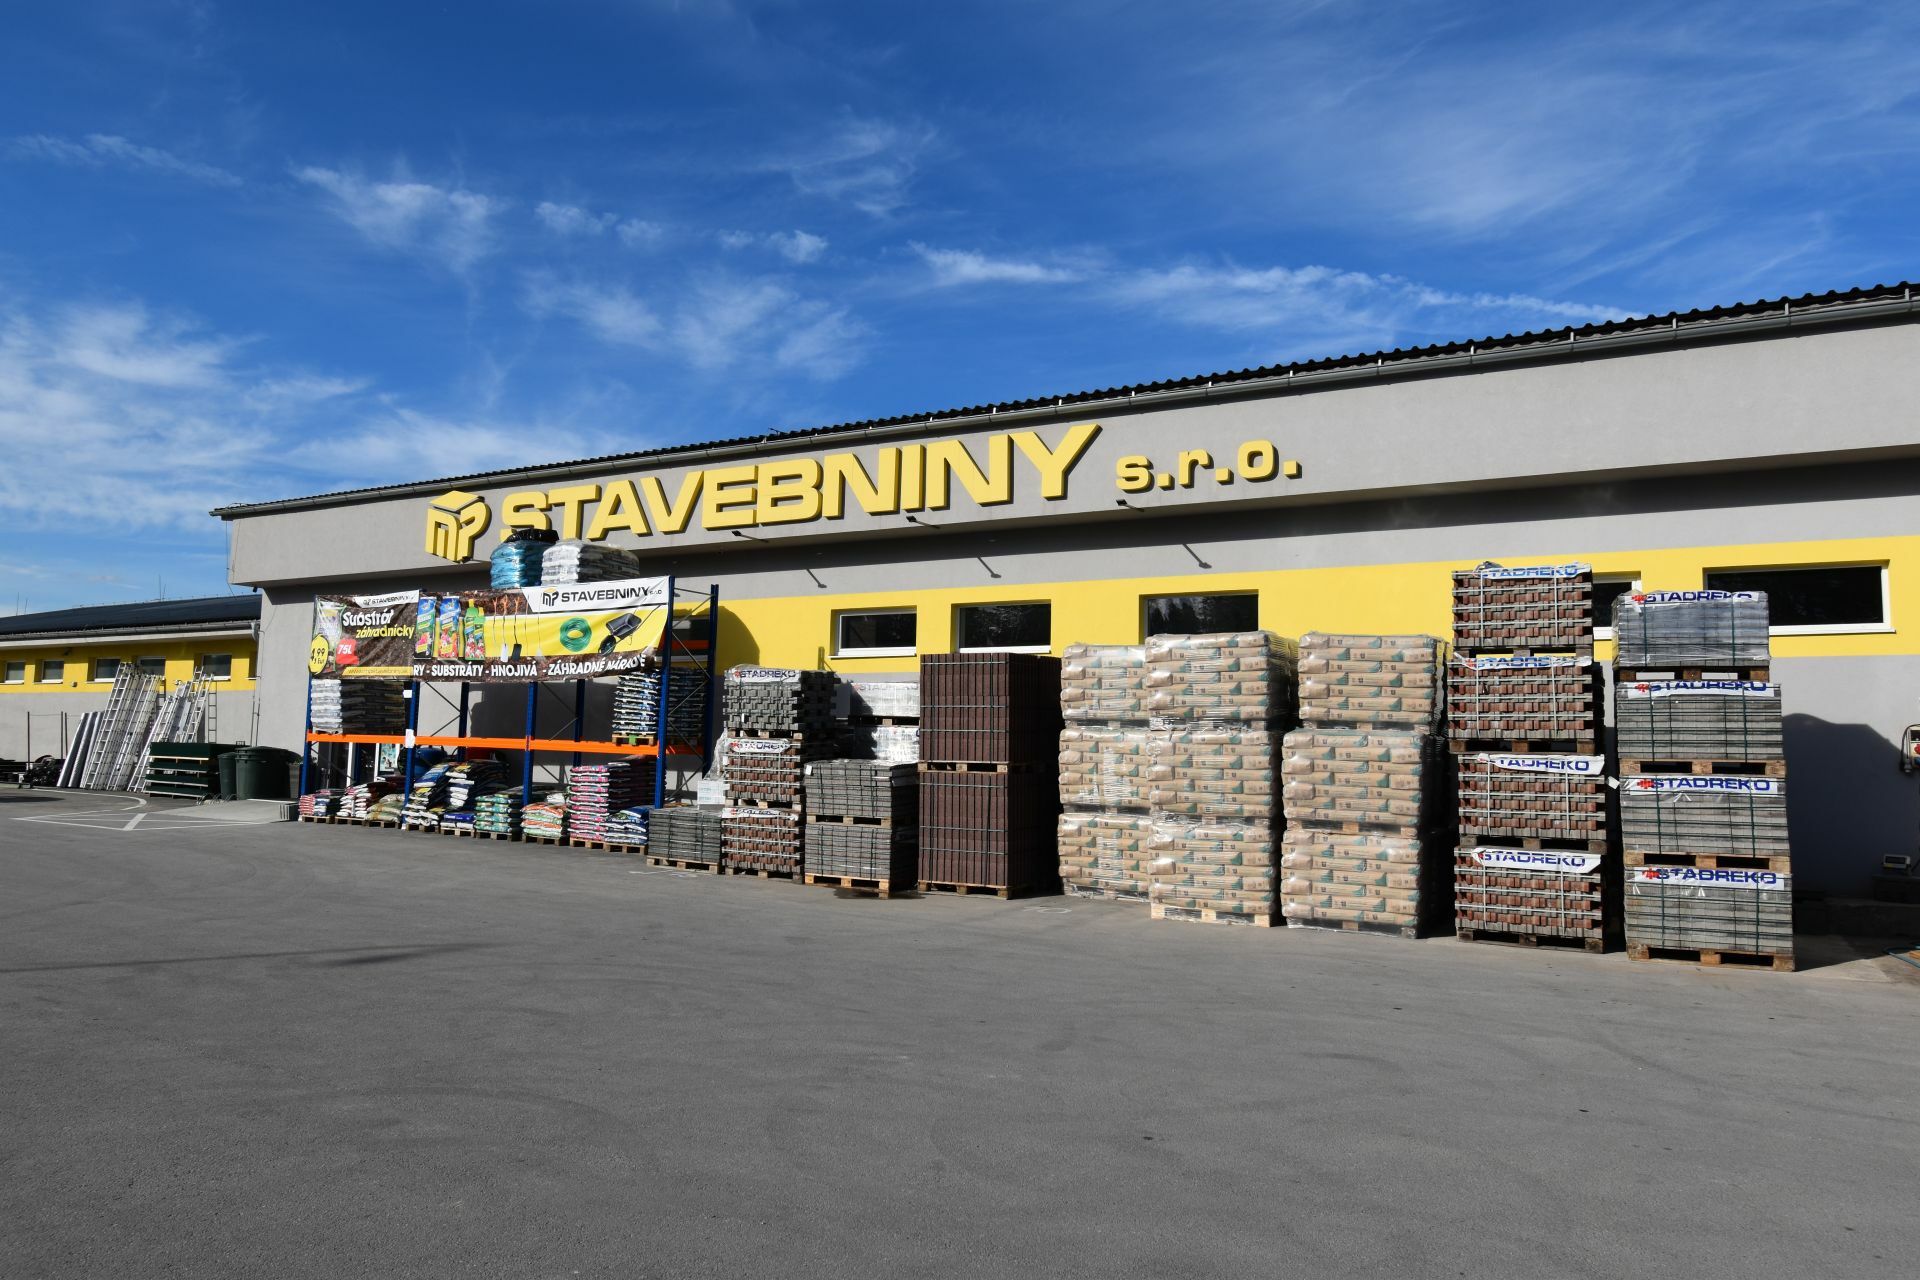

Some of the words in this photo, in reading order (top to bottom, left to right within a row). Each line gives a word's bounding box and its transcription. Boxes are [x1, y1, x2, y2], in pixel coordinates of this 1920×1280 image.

[500, 423, 1103, 543] STAVEBNINY
[1115, 438, 1303, 493] s.r.o.
[561, 586, 650, 602] STAVEBNINY
[342, 609, 395, 626] Substrát
[431, 661, 484, 677] SUBSTRÁTY
[491, 661, 538, 676] HNOJIVÁ
[548, 659, 606, 676] ZÁHRADNÉ
[1653, 777, 1771, 791] STADREKO
[1658, 868, 1777, 885] STADREKO
